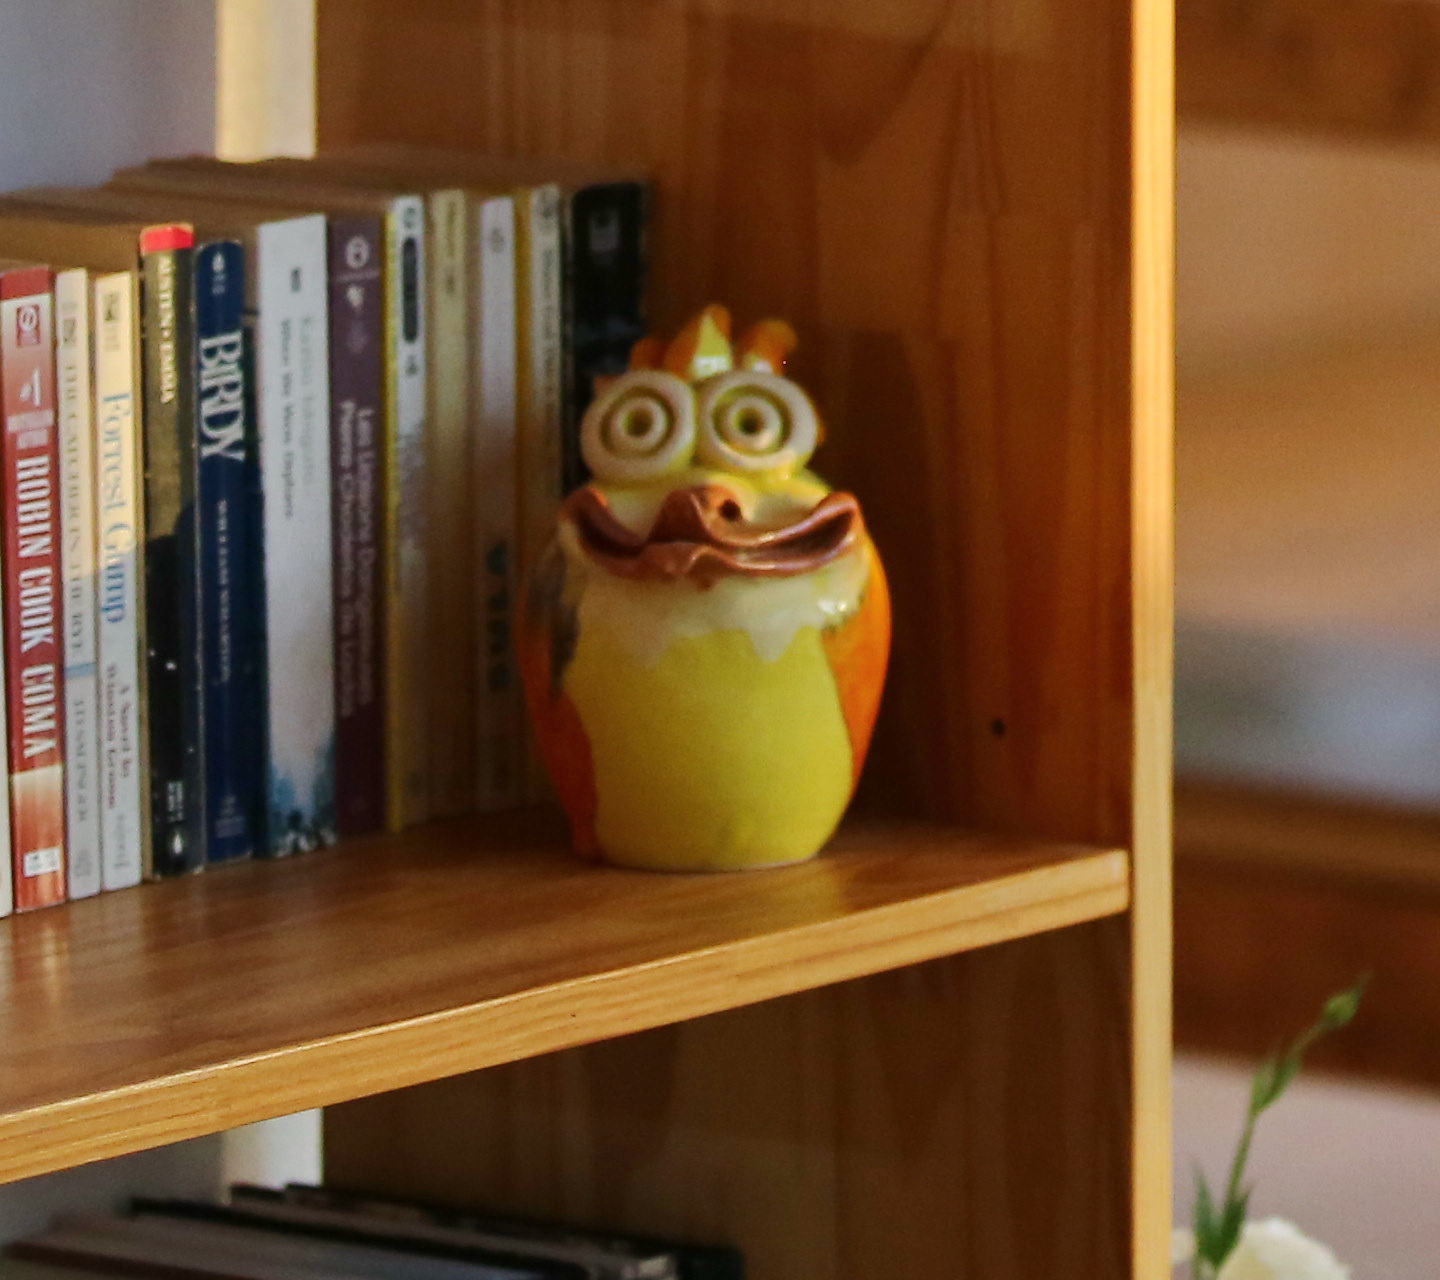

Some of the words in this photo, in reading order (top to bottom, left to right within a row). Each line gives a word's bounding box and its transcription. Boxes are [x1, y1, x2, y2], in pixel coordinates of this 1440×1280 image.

[161, 341, 177, 405] EMMA
[199, 330, 247, 463] BIRDY
[101, 391, 133, 511] Forrest
[14, 455, 52, 559] ROBIN
[18, 569, 55, 654] COOK
[100, 522, 137, 625] Gump
[21, 662, 57, 759] COMA
